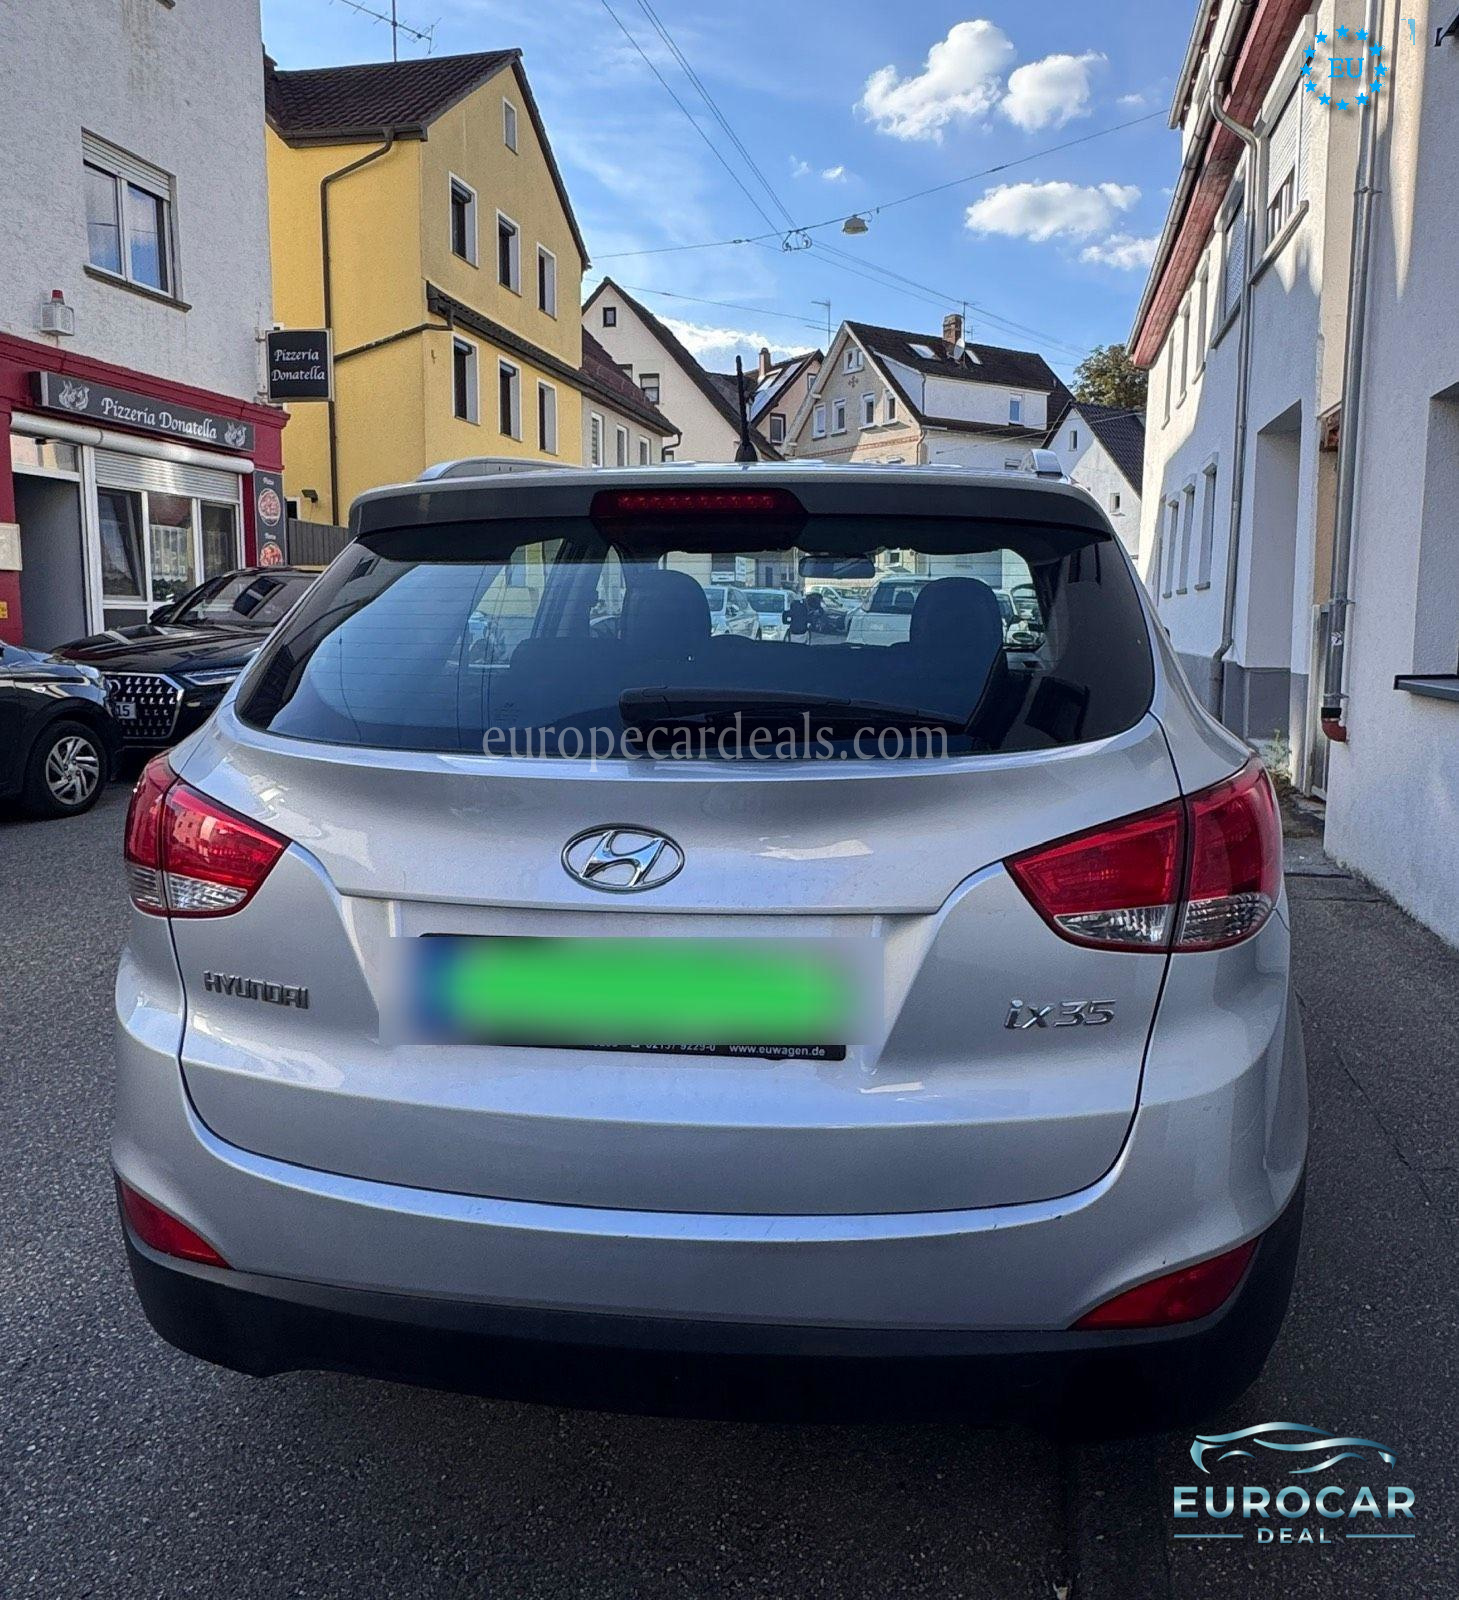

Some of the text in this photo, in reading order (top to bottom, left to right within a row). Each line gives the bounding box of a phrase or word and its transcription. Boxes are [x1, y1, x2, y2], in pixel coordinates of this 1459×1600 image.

[273, 348, 320, 362] Pizzeria
[271, 365, 326, 382] Donatella
[101, 397, 218, 439] Pizzeria Donatella
[203, 970, 309, 1010] HYUNDAI
[1003, 999, 1116, 1029] ix35
[729, 1044, 826, 1057] www.euwagen.de
